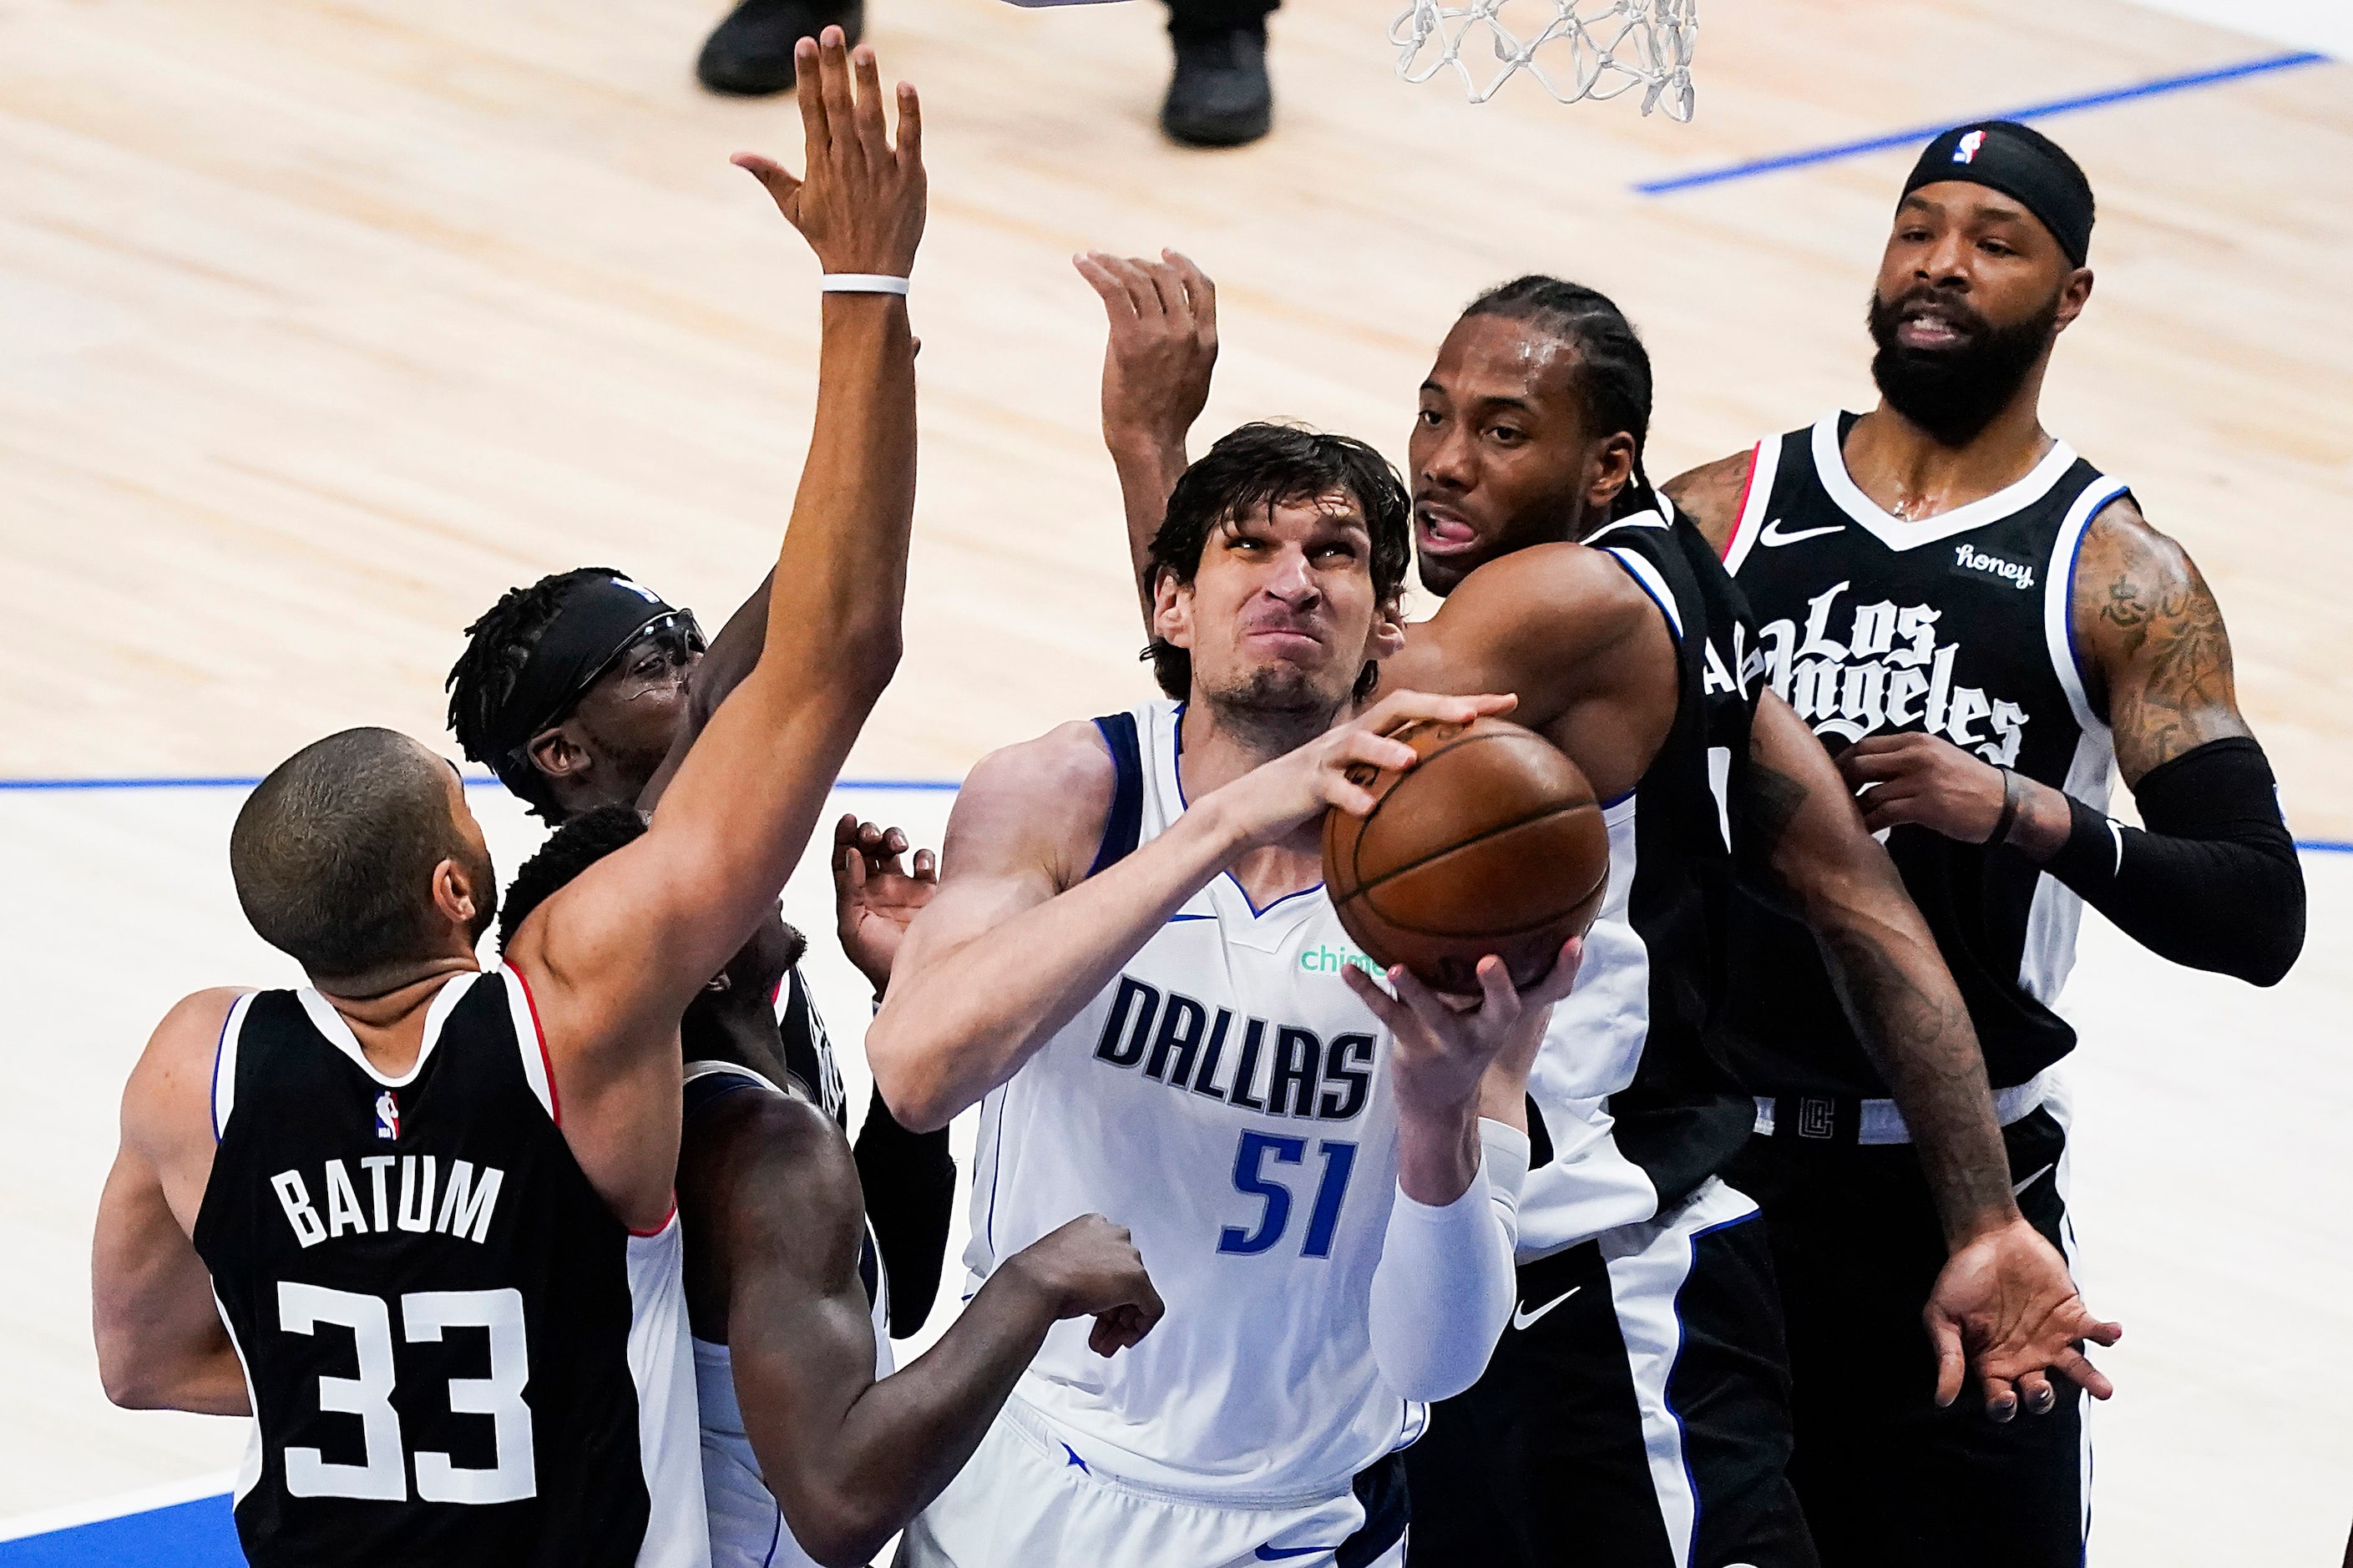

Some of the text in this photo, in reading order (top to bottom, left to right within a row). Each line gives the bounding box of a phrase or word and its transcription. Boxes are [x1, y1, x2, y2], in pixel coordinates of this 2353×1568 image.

[1804, 580, 1941, 666] Los
[1956, 544, 2035, 589] honey
[1758, 619, 2029, 767] Angeles
[1093, 974, 1377, 1120] DALLAS
[271, 1156, 504, 1248] BATUM
[1217, 1129, 1359, 1259] 51
[277, 1282, 537, 1505] 33
